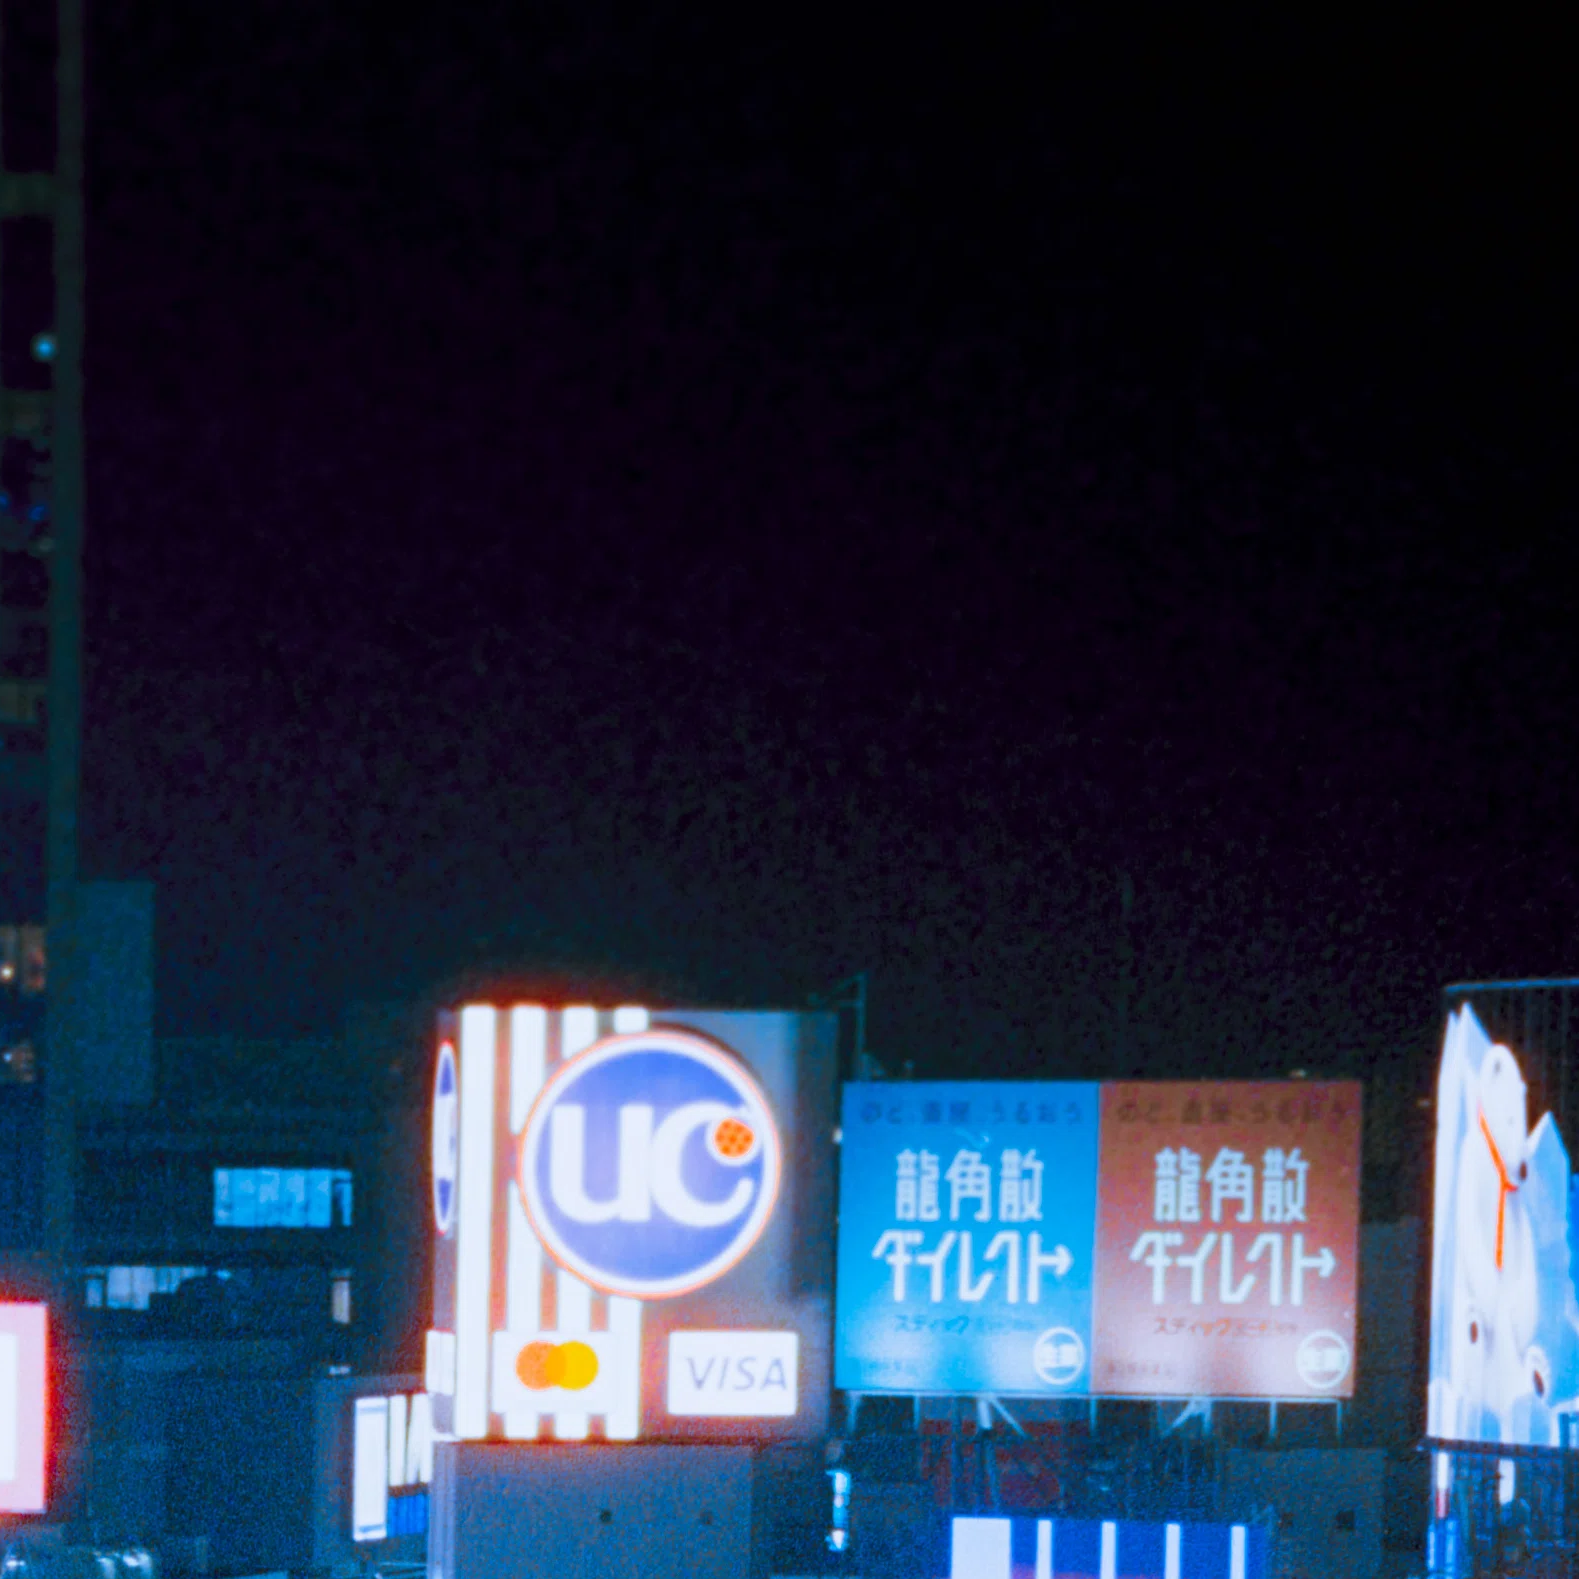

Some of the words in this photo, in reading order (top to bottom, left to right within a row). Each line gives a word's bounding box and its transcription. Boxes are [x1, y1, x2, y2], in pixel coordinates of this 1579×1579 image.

[895, 1148, 1044, 1223] 龍角散
[1153, 1146, 1310, 1224] 龍角散
[872, 1230, 1075, 1304] ダイレクト
[1129, 1230, 1336, 1306] ダイレクト
[686, 1356, 788, 1391] VISA
